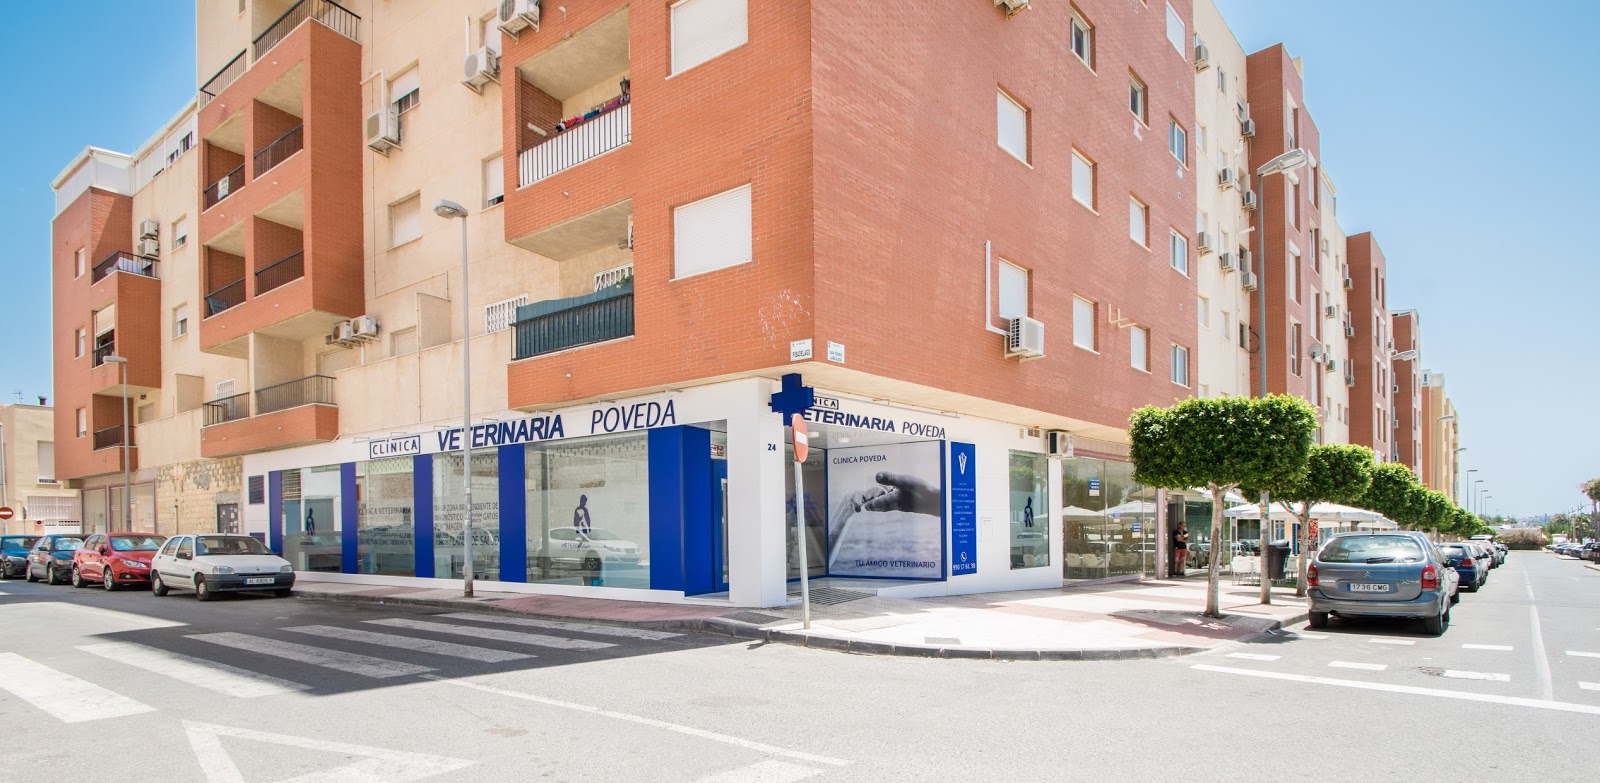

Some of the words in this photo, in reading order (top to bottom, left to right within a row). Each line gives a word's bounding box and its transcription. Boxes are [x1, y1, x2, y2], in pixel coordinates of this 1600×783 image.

[813, 398, 837, 408] NICA
[372, 438, 418, 455] CLÍNICA
[590, 399, 676, 434] POVEDA
[803, 408, 896, 432] ETERINARIA
[902, 422, 946, 439] POVEDA
[832, 456, 858, 464] CLINICA
[860, 454, 886, 462] POVEDA
